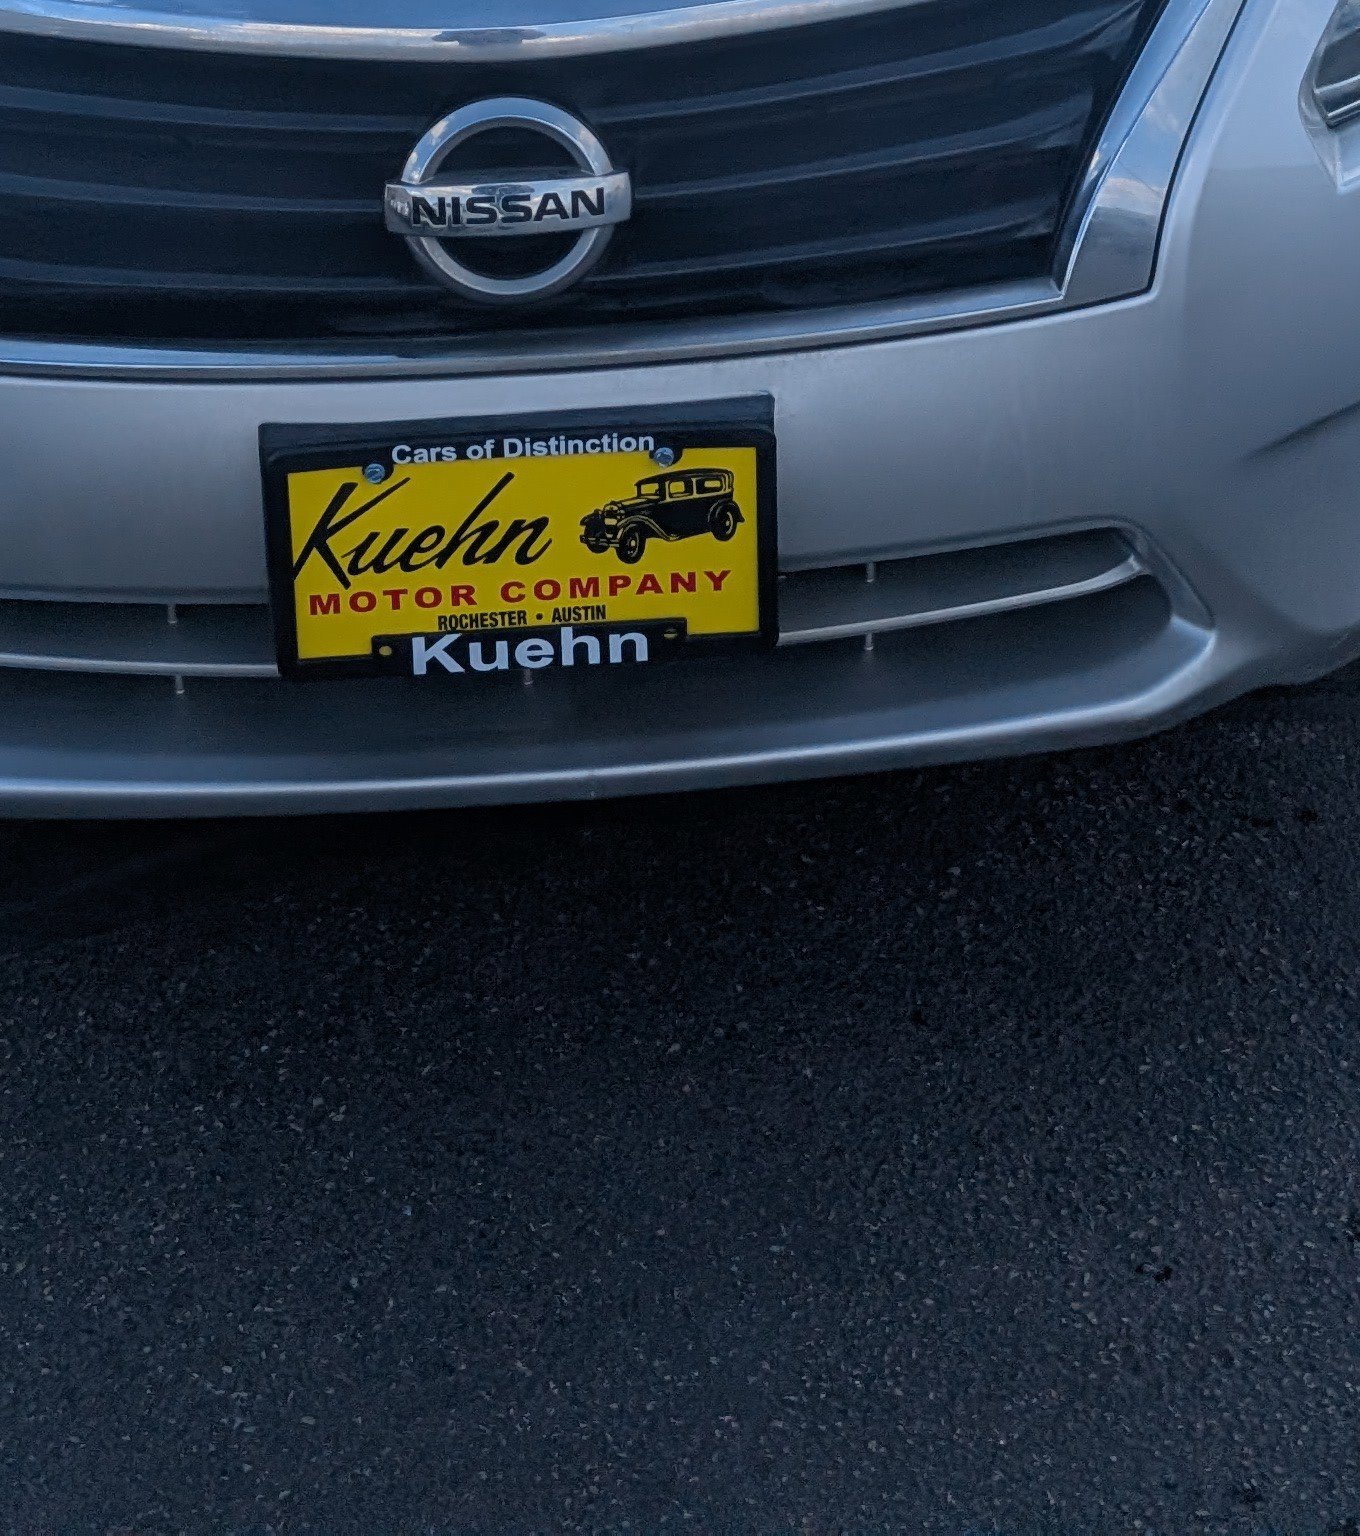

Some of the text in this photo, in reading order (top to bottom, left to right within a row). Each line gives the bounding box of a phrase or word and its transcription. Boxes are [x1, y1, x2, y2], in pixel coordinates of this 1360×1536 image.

[411, 187, 606, 226] NISSAN
[391, 432, 656, 465] Cars of Distinction
[293, 471, 553, 590] Kuehn
[309, 569, 733, 616] MOTOR COMPANY
[437, 604, 607, 631] ROCHESTER AUSTIN
[411, 626, 650, 676] Kuehn
